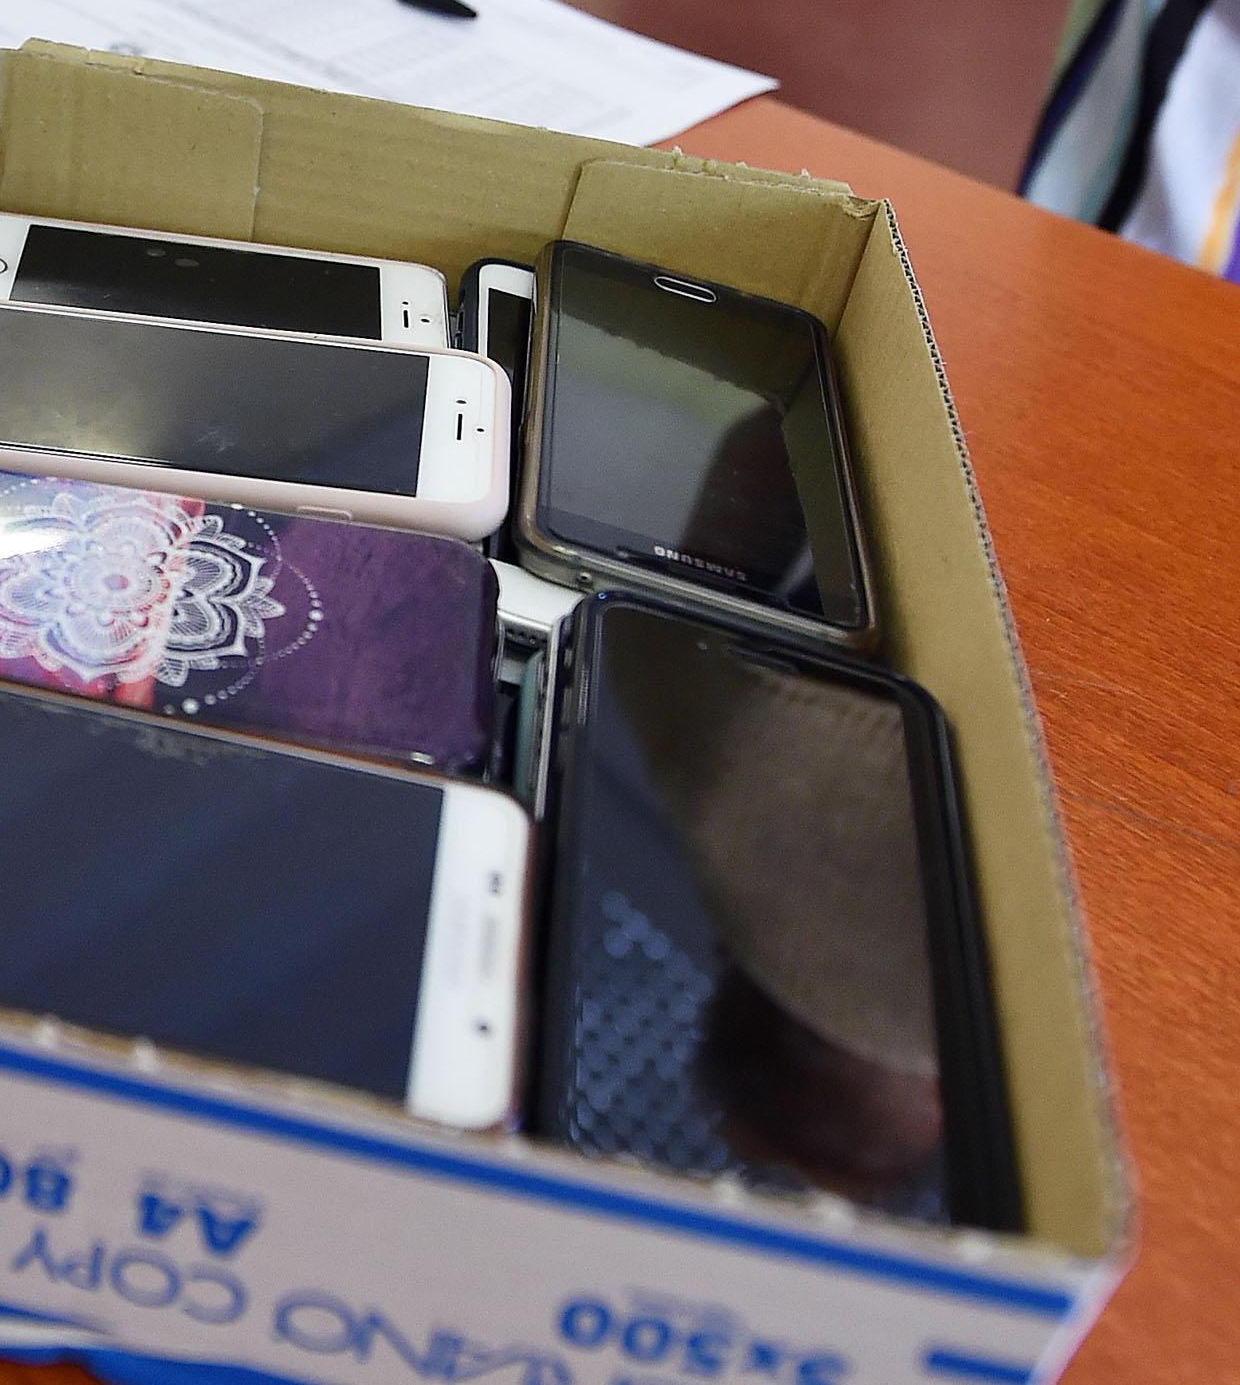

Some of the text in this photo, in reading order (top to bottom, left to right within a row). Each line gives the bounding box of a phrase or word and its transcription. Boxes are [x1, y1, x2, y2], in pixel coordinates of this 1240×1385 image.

[653, 544, 746, 581] SAMSUNG
[138, 1191, 258, 1255] A4
[12, 1227, 248, 1325] COPY
